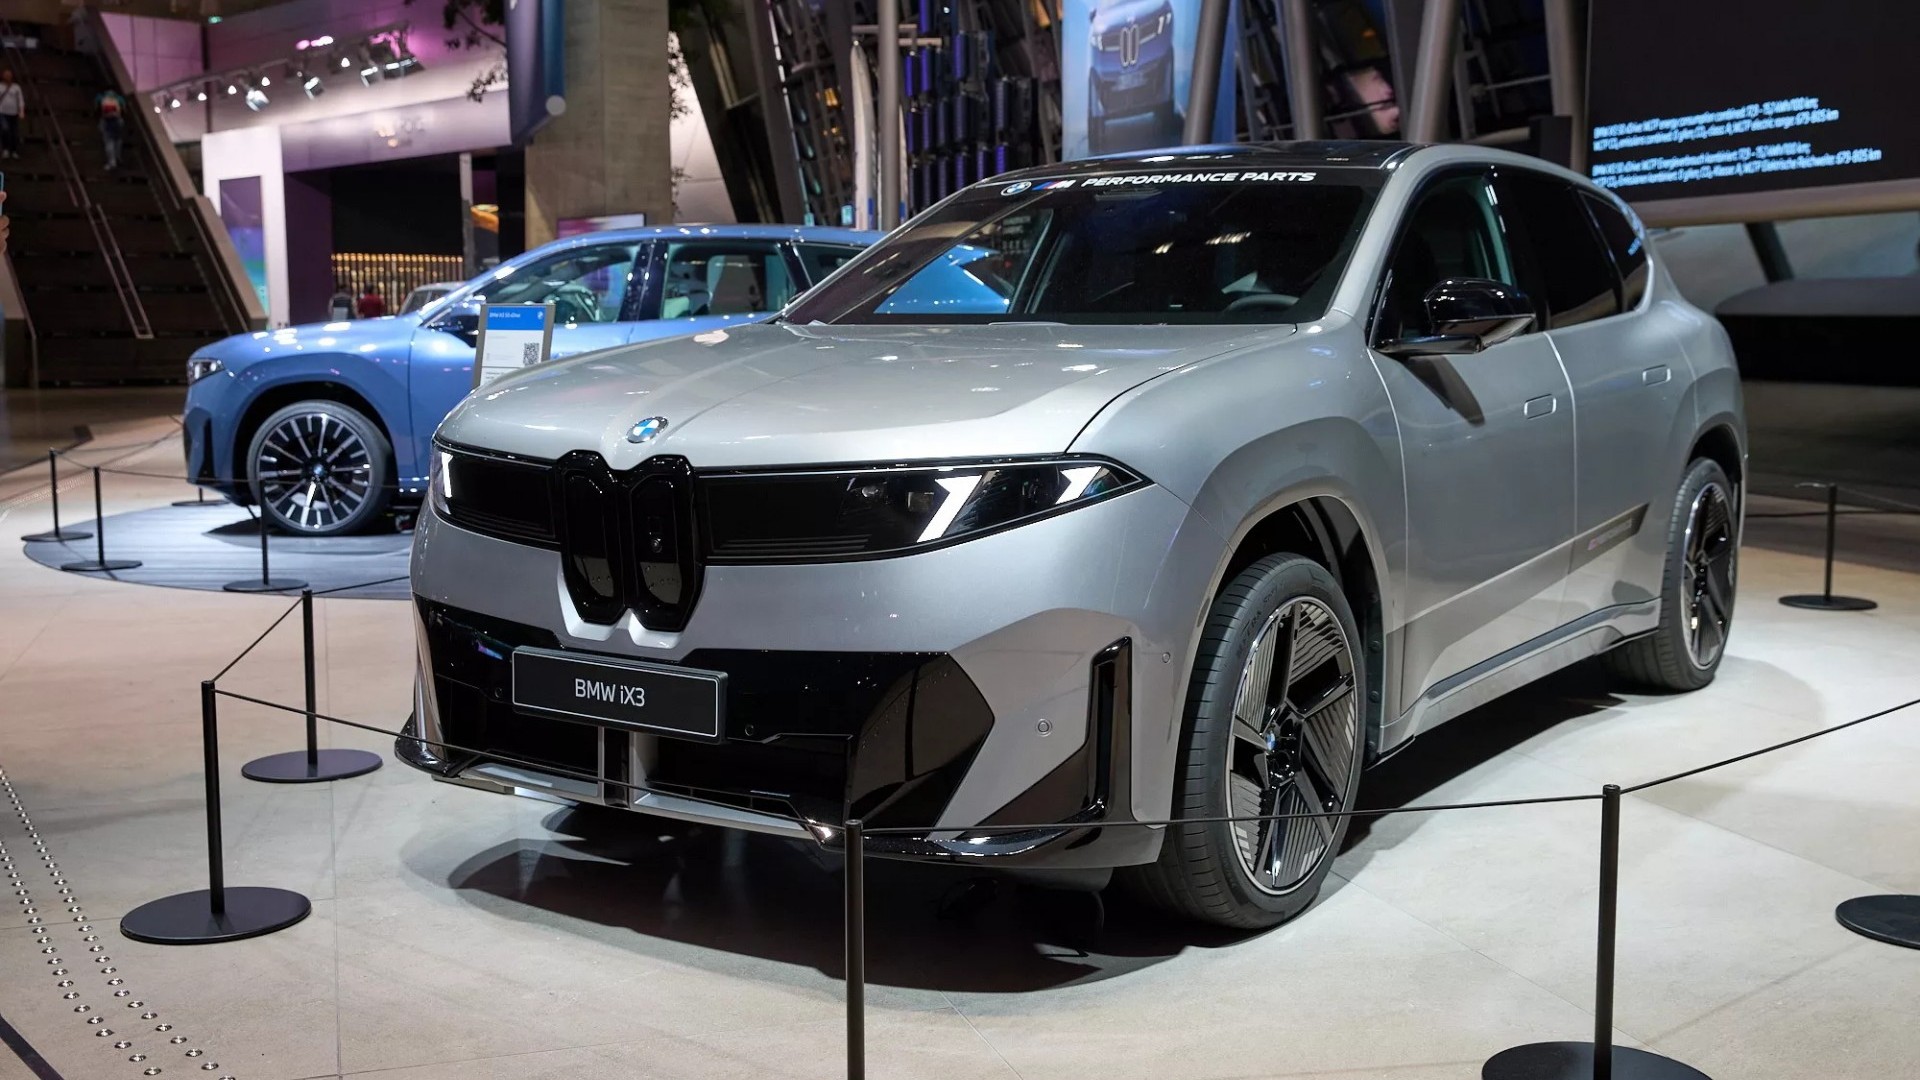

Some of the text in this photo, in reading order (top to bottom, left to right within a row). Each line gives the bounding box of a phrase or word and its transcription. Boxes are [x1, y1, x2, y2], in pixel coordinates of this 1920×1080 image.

[1081, 171, 1237, 188] PERFORMANCE
[1239, 171, 1316, 183] PARTS
[575, 678, 645, 707] BMW iX3
